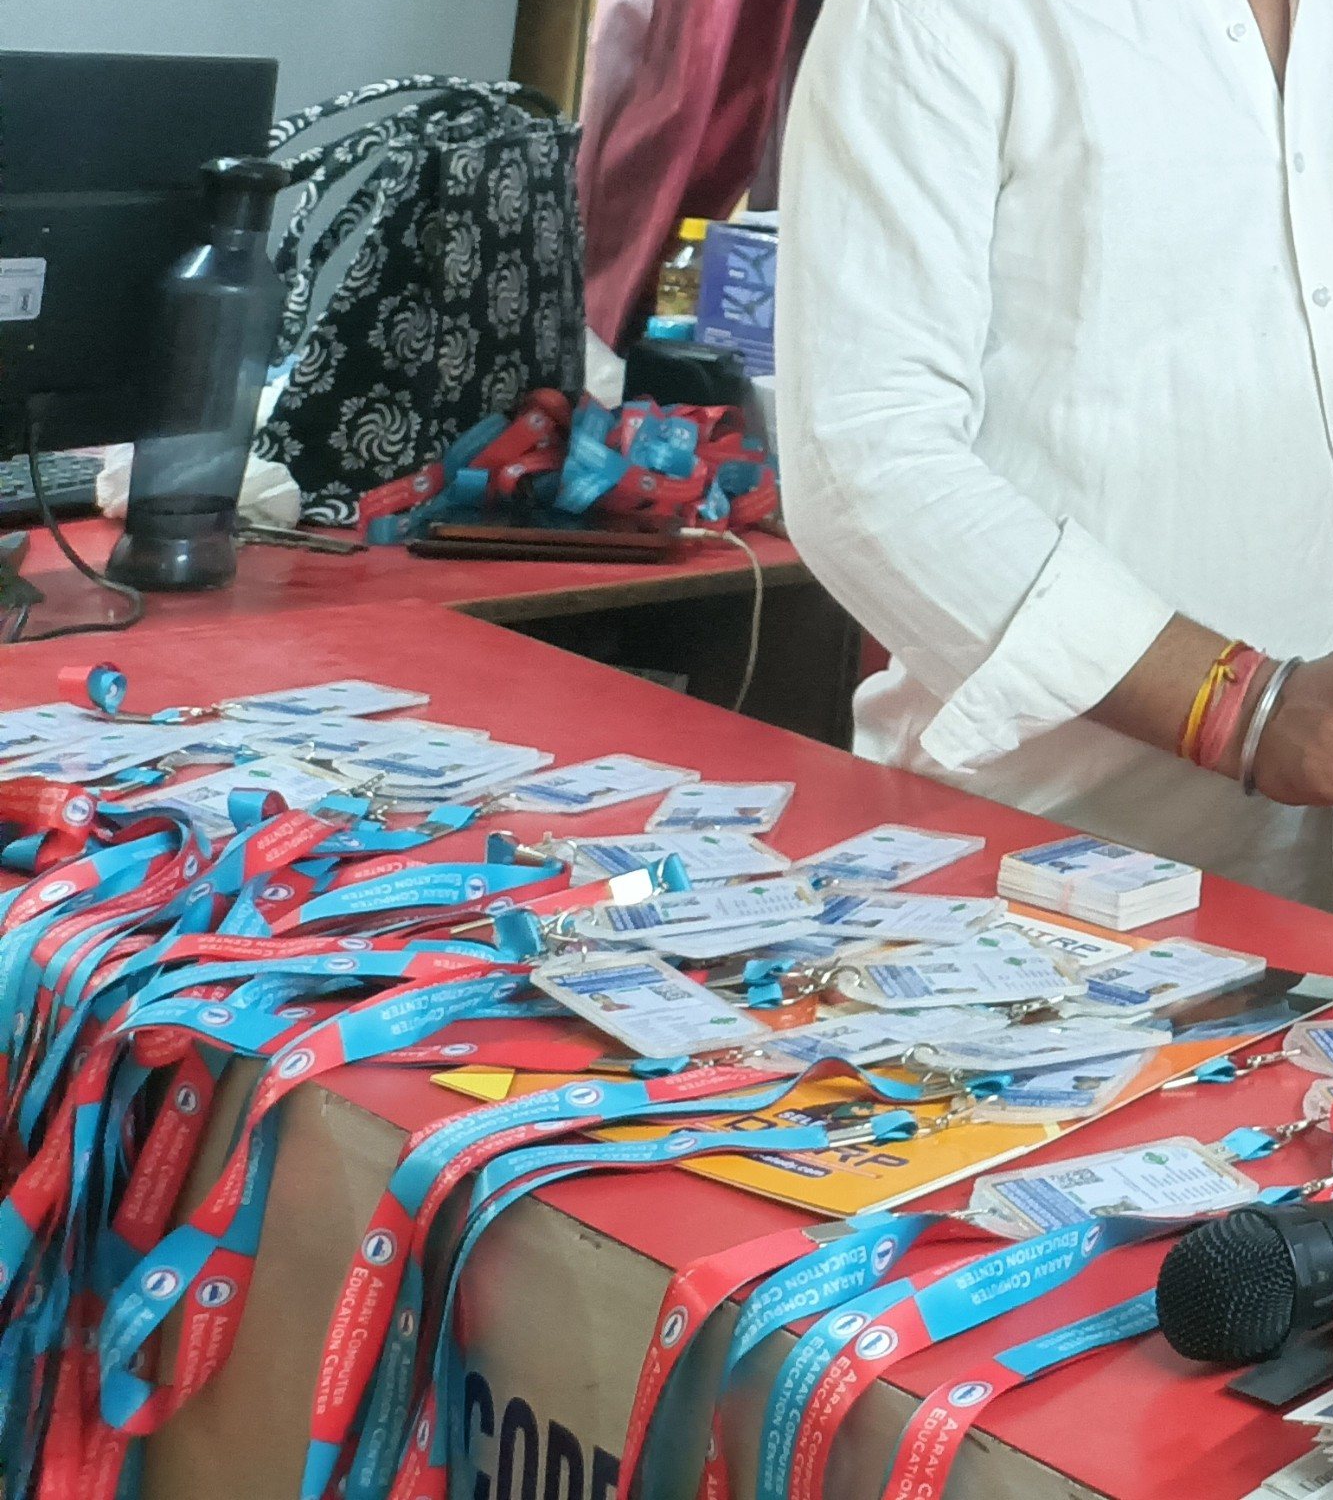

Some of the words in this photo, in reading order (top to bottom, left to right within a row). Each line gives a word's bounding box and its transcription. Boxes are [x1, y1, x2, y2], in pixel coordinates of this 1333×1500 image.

[1006, 1231, 1080, 1263] EDUCATION
[785, 1246, 867, 1289] EDUCATION
[822, 1269, 866, 1294] AARAV
[955, 1258, 1004, 1289] CENTER
[1035, 1252, 1073, 1280] AARAV
[971, 1271, 1031, 1306] COMPUTER
[329, 1267, 370, 1351] EDUCATION
